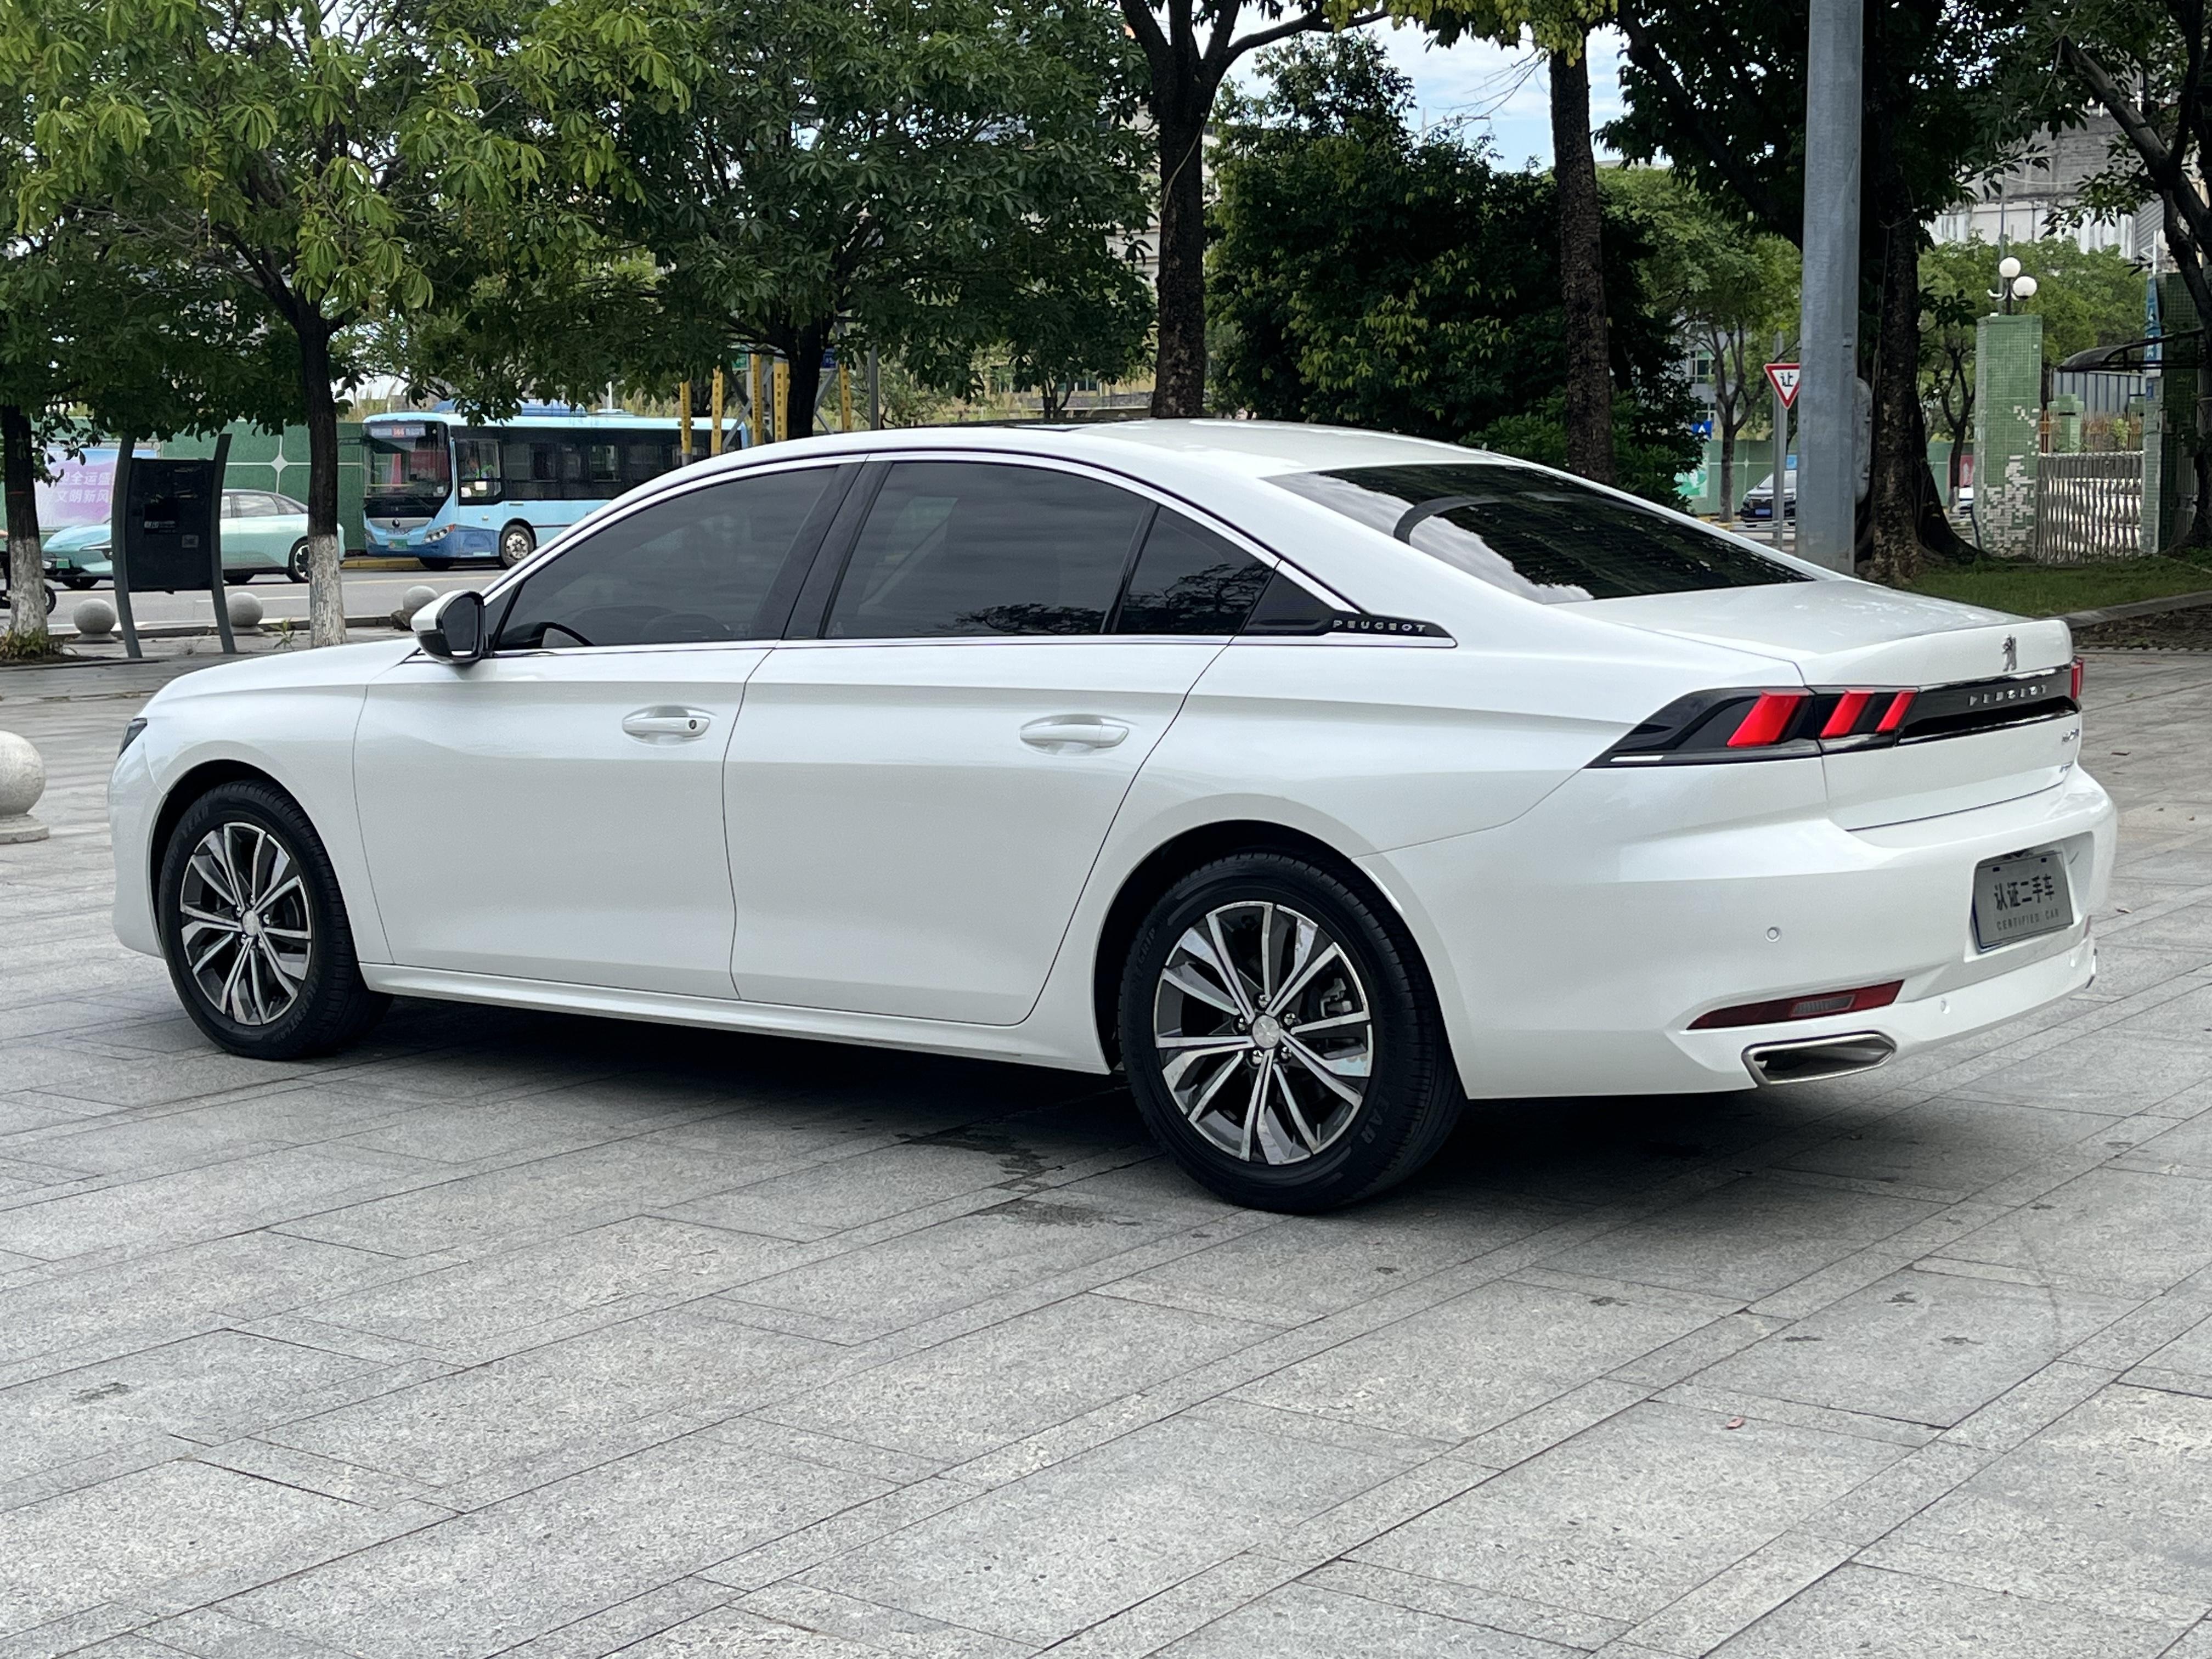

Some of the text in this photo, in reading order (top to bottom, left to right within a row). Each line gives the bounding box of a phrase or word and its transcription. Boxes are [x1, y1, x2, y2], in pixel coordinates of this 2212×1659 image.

[1780, 371, 1793, 387] 让
[1333, 619, 1426, 632] PEUGEOT
[1994, 873, 2054, 911] 认证二手车
[1997, 908, 2059, 931] CERTIFIED CAR
